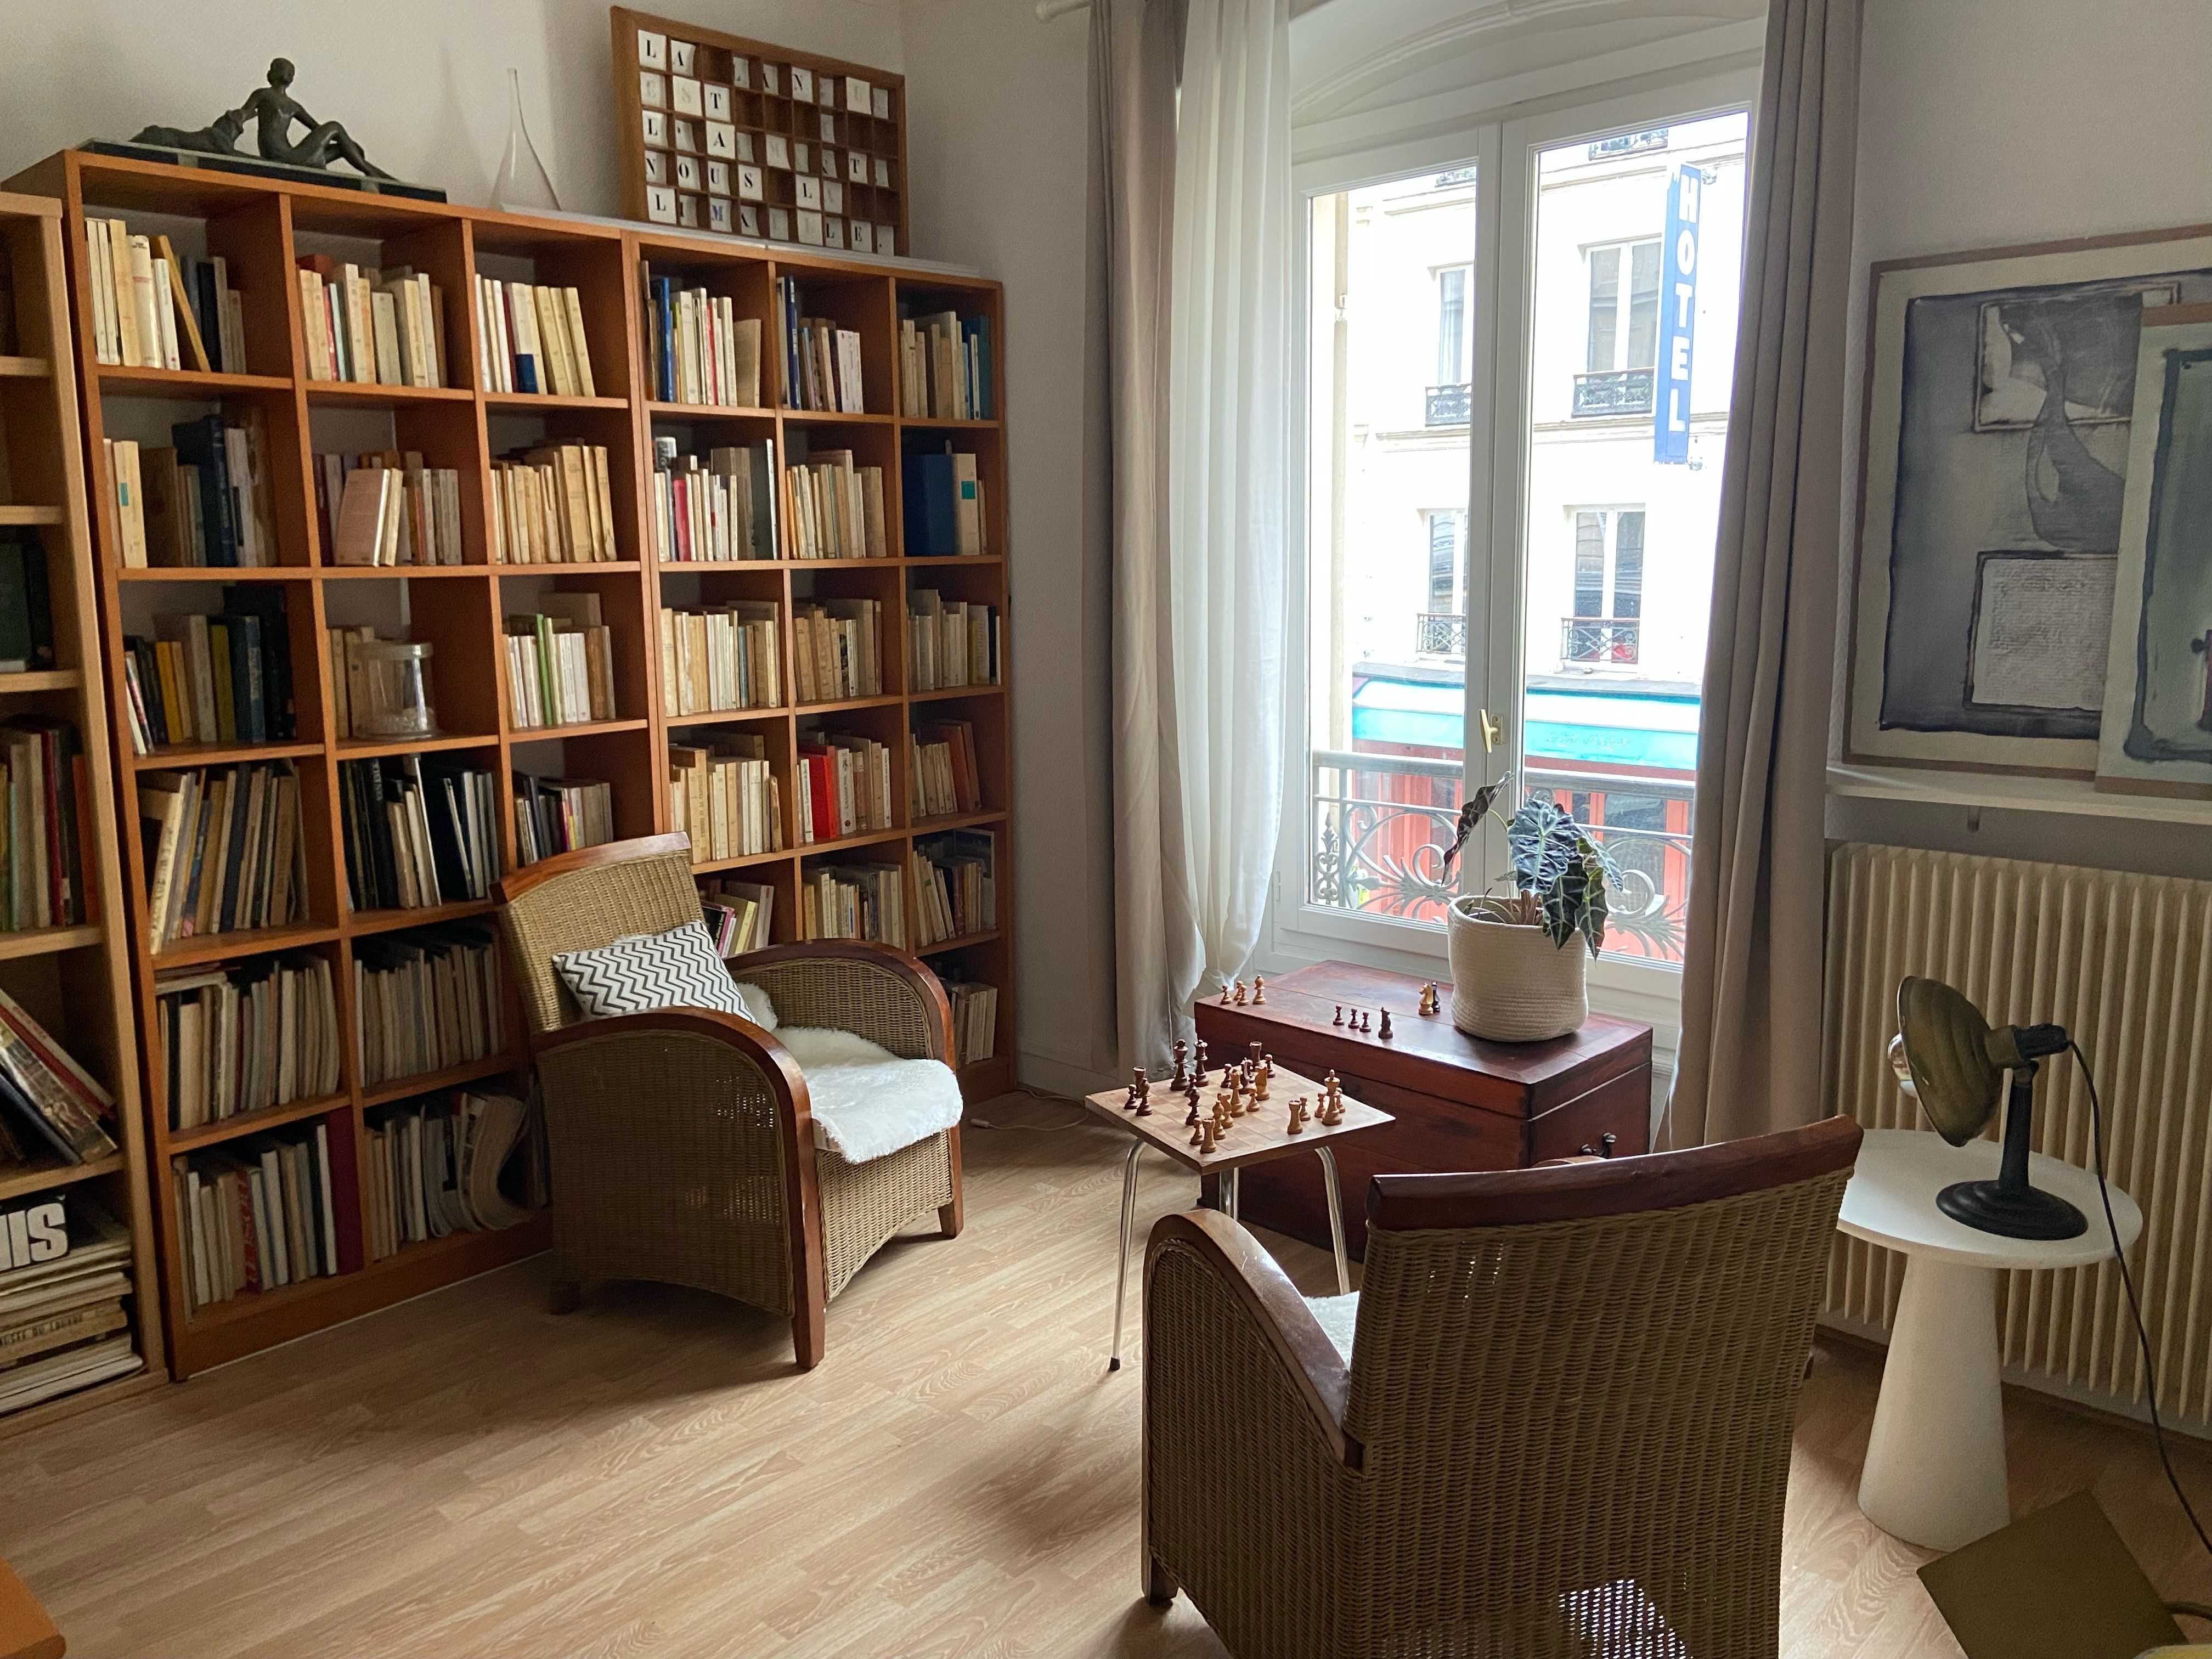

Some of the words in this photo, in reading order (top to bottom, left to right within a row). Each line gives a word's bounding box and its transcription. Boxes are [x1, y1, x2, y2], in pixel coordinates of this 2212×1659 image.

[646, 40, 684, 67] LA
[646, 159, 753, 189] NOUS
[1668, 174, 1699, 432] HOTEL
